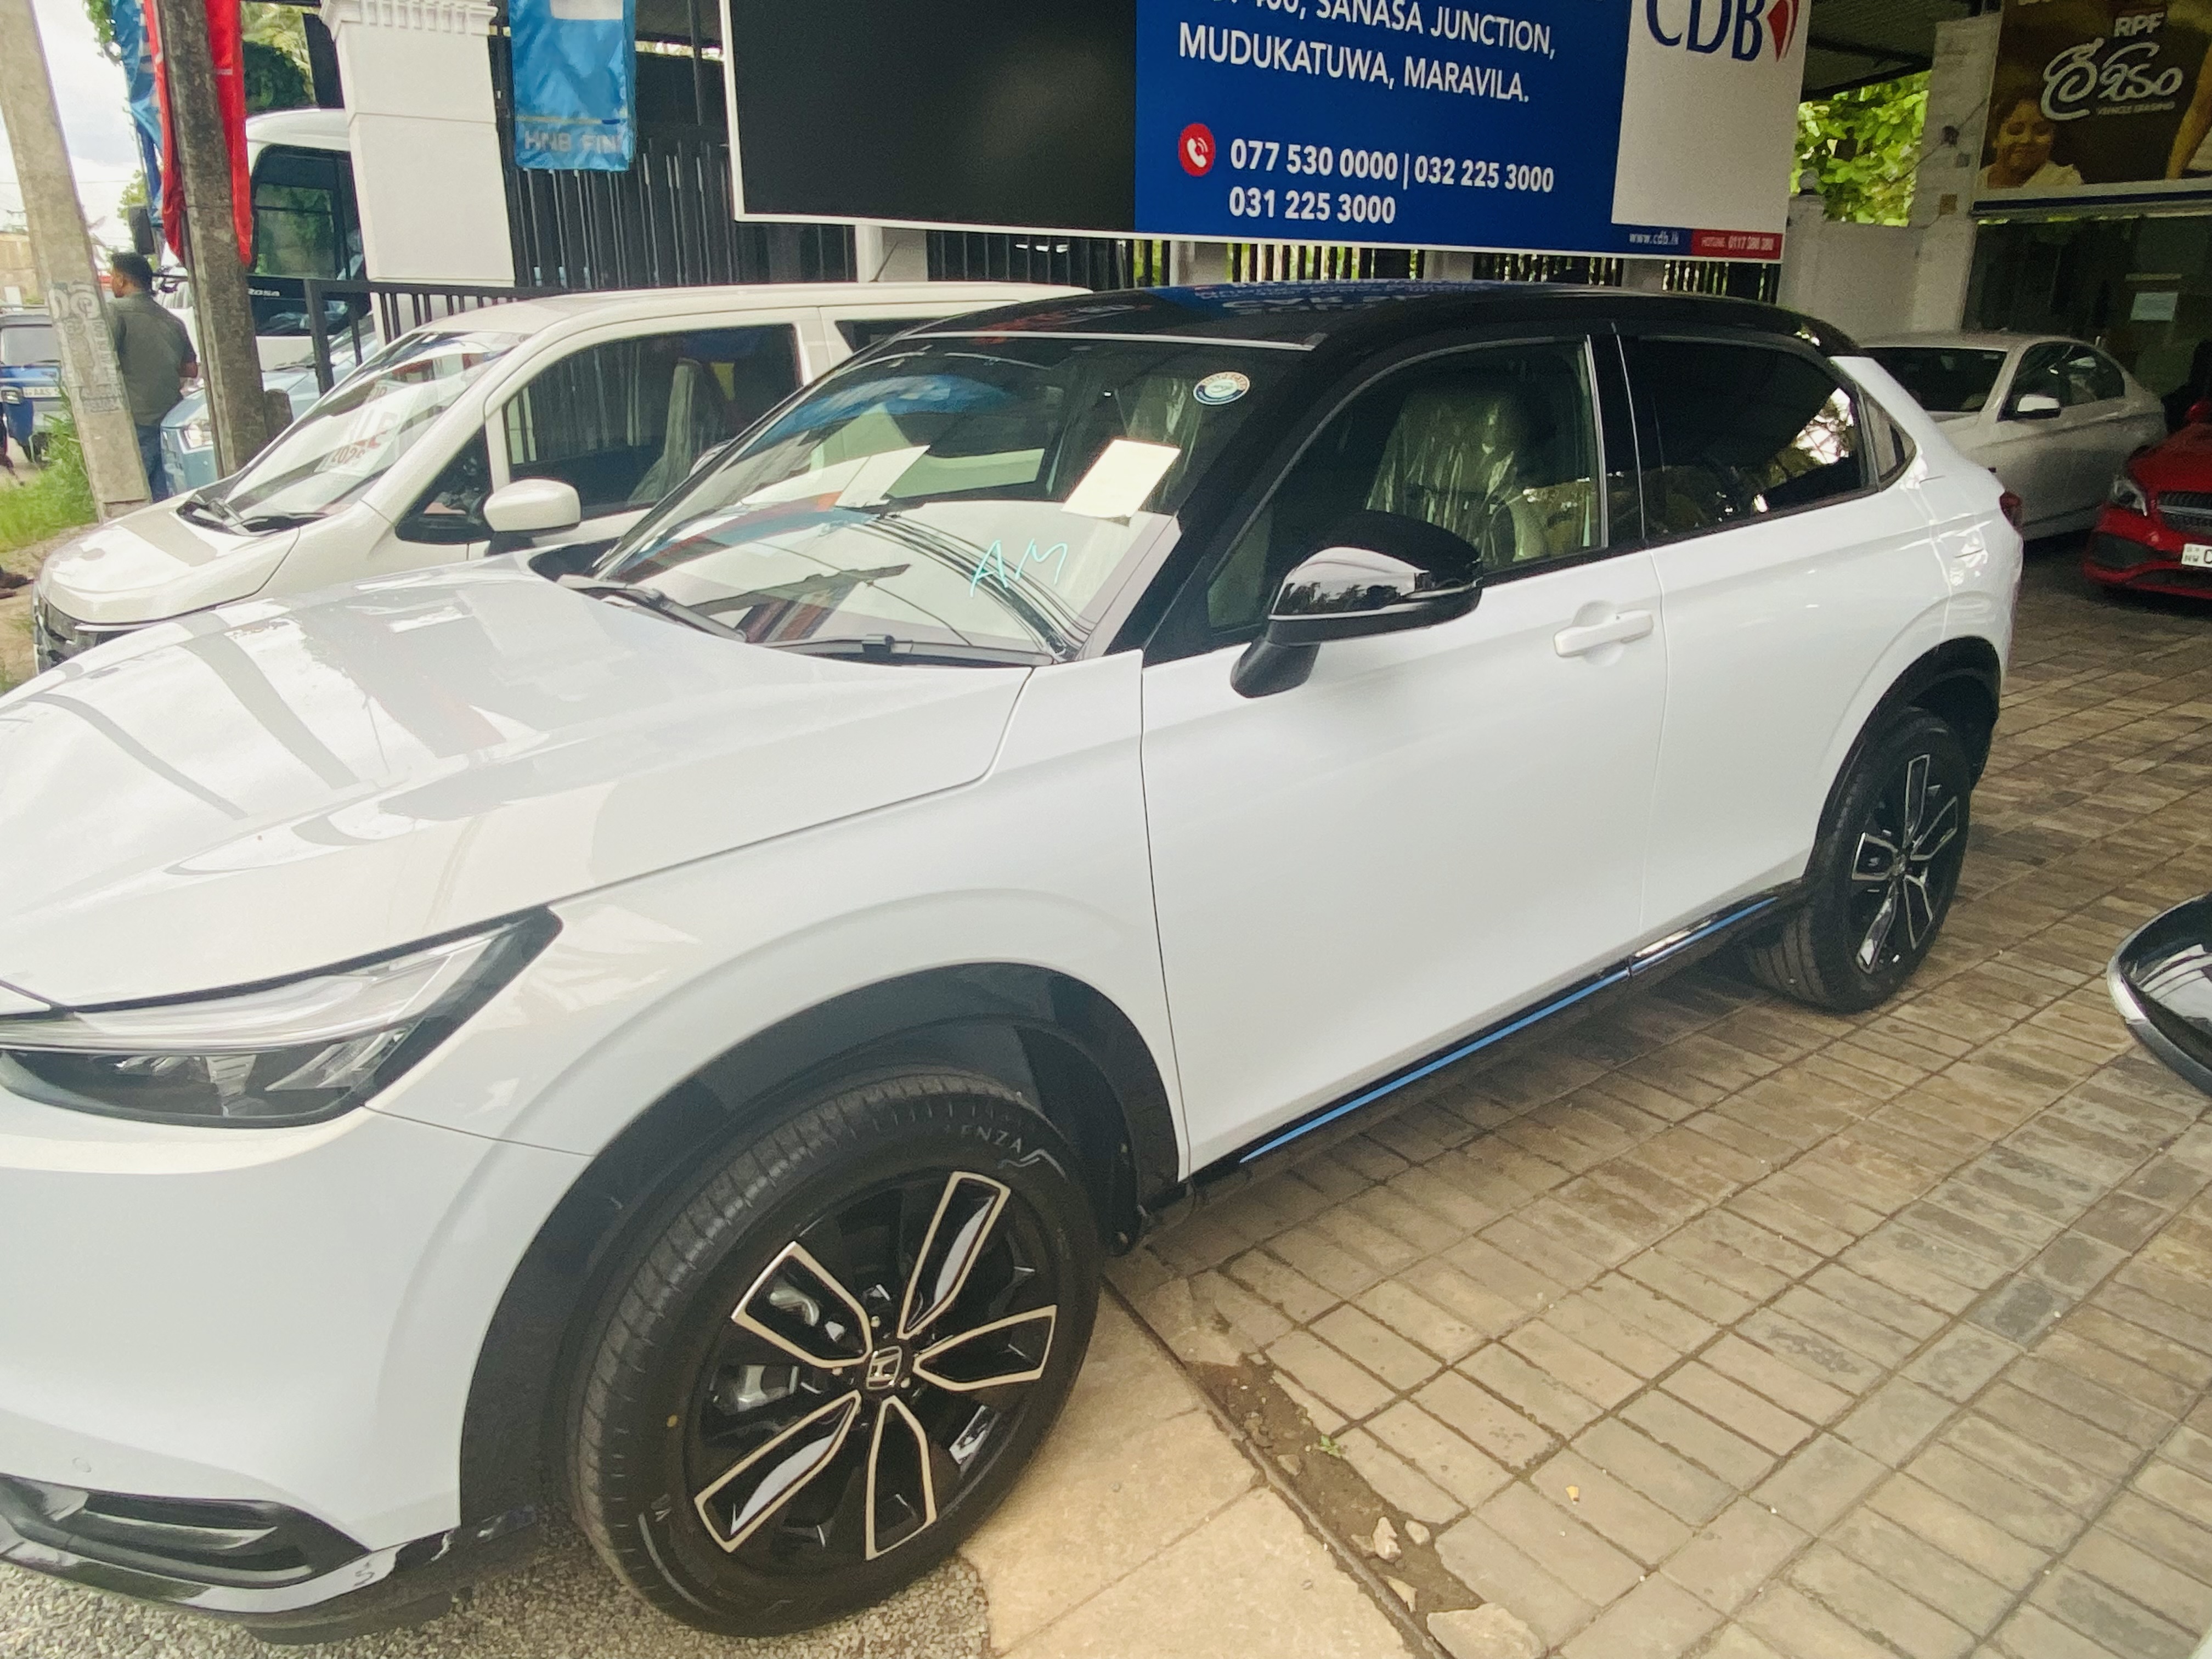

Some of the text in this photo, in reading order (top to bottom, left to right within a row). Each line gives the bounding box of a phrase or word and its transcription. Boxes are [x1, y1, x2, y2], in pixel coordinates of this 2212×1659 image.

[1317, 0, 1423, 34] SANASA
[1430, 6, 1555, 59] JUNCTION,
[1646, 0, 1765, 61] CDB
[2114, 12, 2164, 37] RPF
[1180, 22, 1529, 102] MUDUKATUWA, MARAVILA.
[524, 130, 571, 152] HNB
[1231, 139, 1279, 171] 077
[1286, 144, 1333, 176] 530
[1340, 148, 1398, 180] 0000
[1414, 155, 1455, 184] 032
[1460, 159, 1499, 188] 225
[1504, 163, 1554, 192] 3000
[1229, 187, 1396, 224] 031 225 3000
[970, 538, 1068, 597] AM
